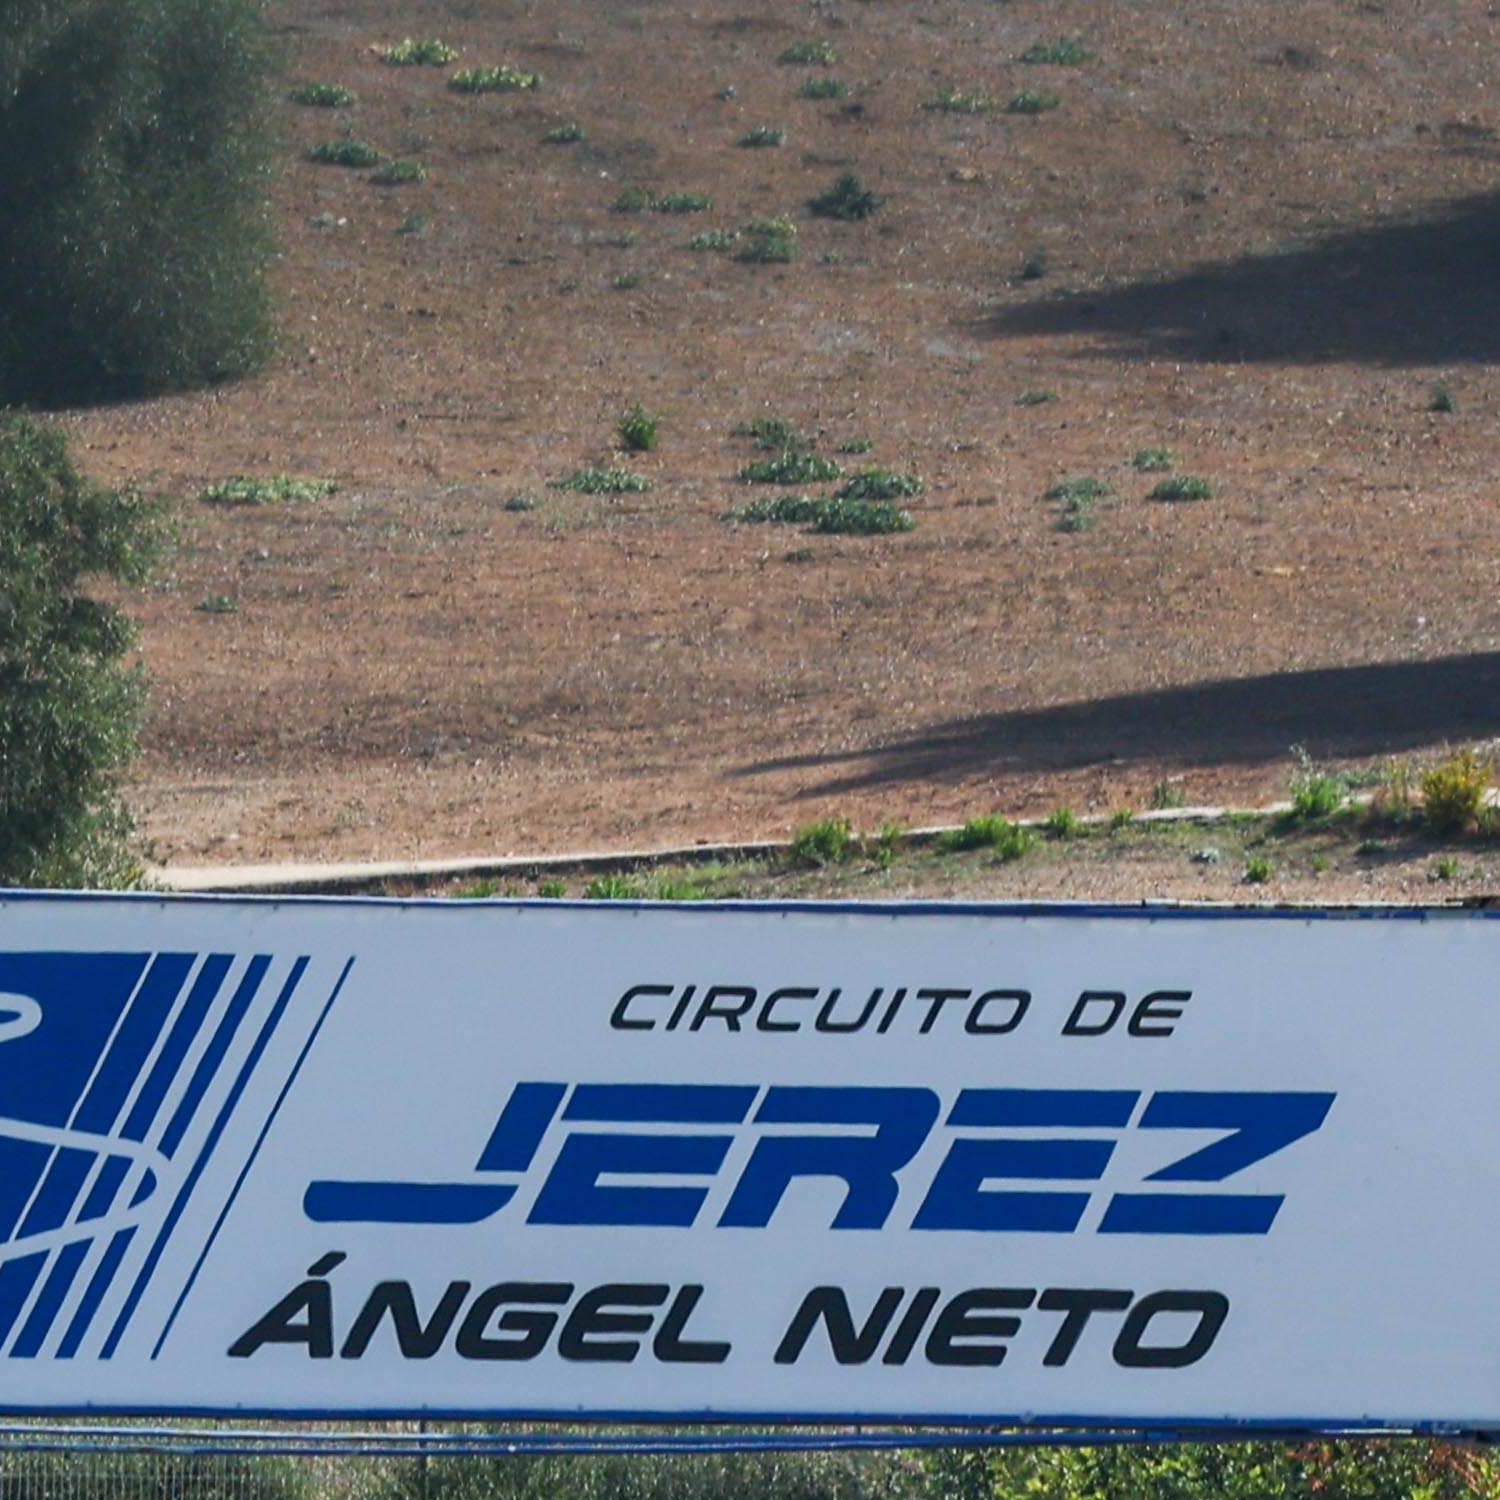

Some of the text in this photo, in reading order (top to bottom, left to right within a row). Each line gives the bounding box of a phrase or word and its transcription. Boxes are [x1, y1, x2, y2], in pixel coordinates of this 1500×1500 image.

[609, 984, 1193, 1038] CIRCUITO DE
[302, 1081, 1338, 1236] JEREZ
[226, 1250, 1230, 1369] ÁNGEL NIETO
